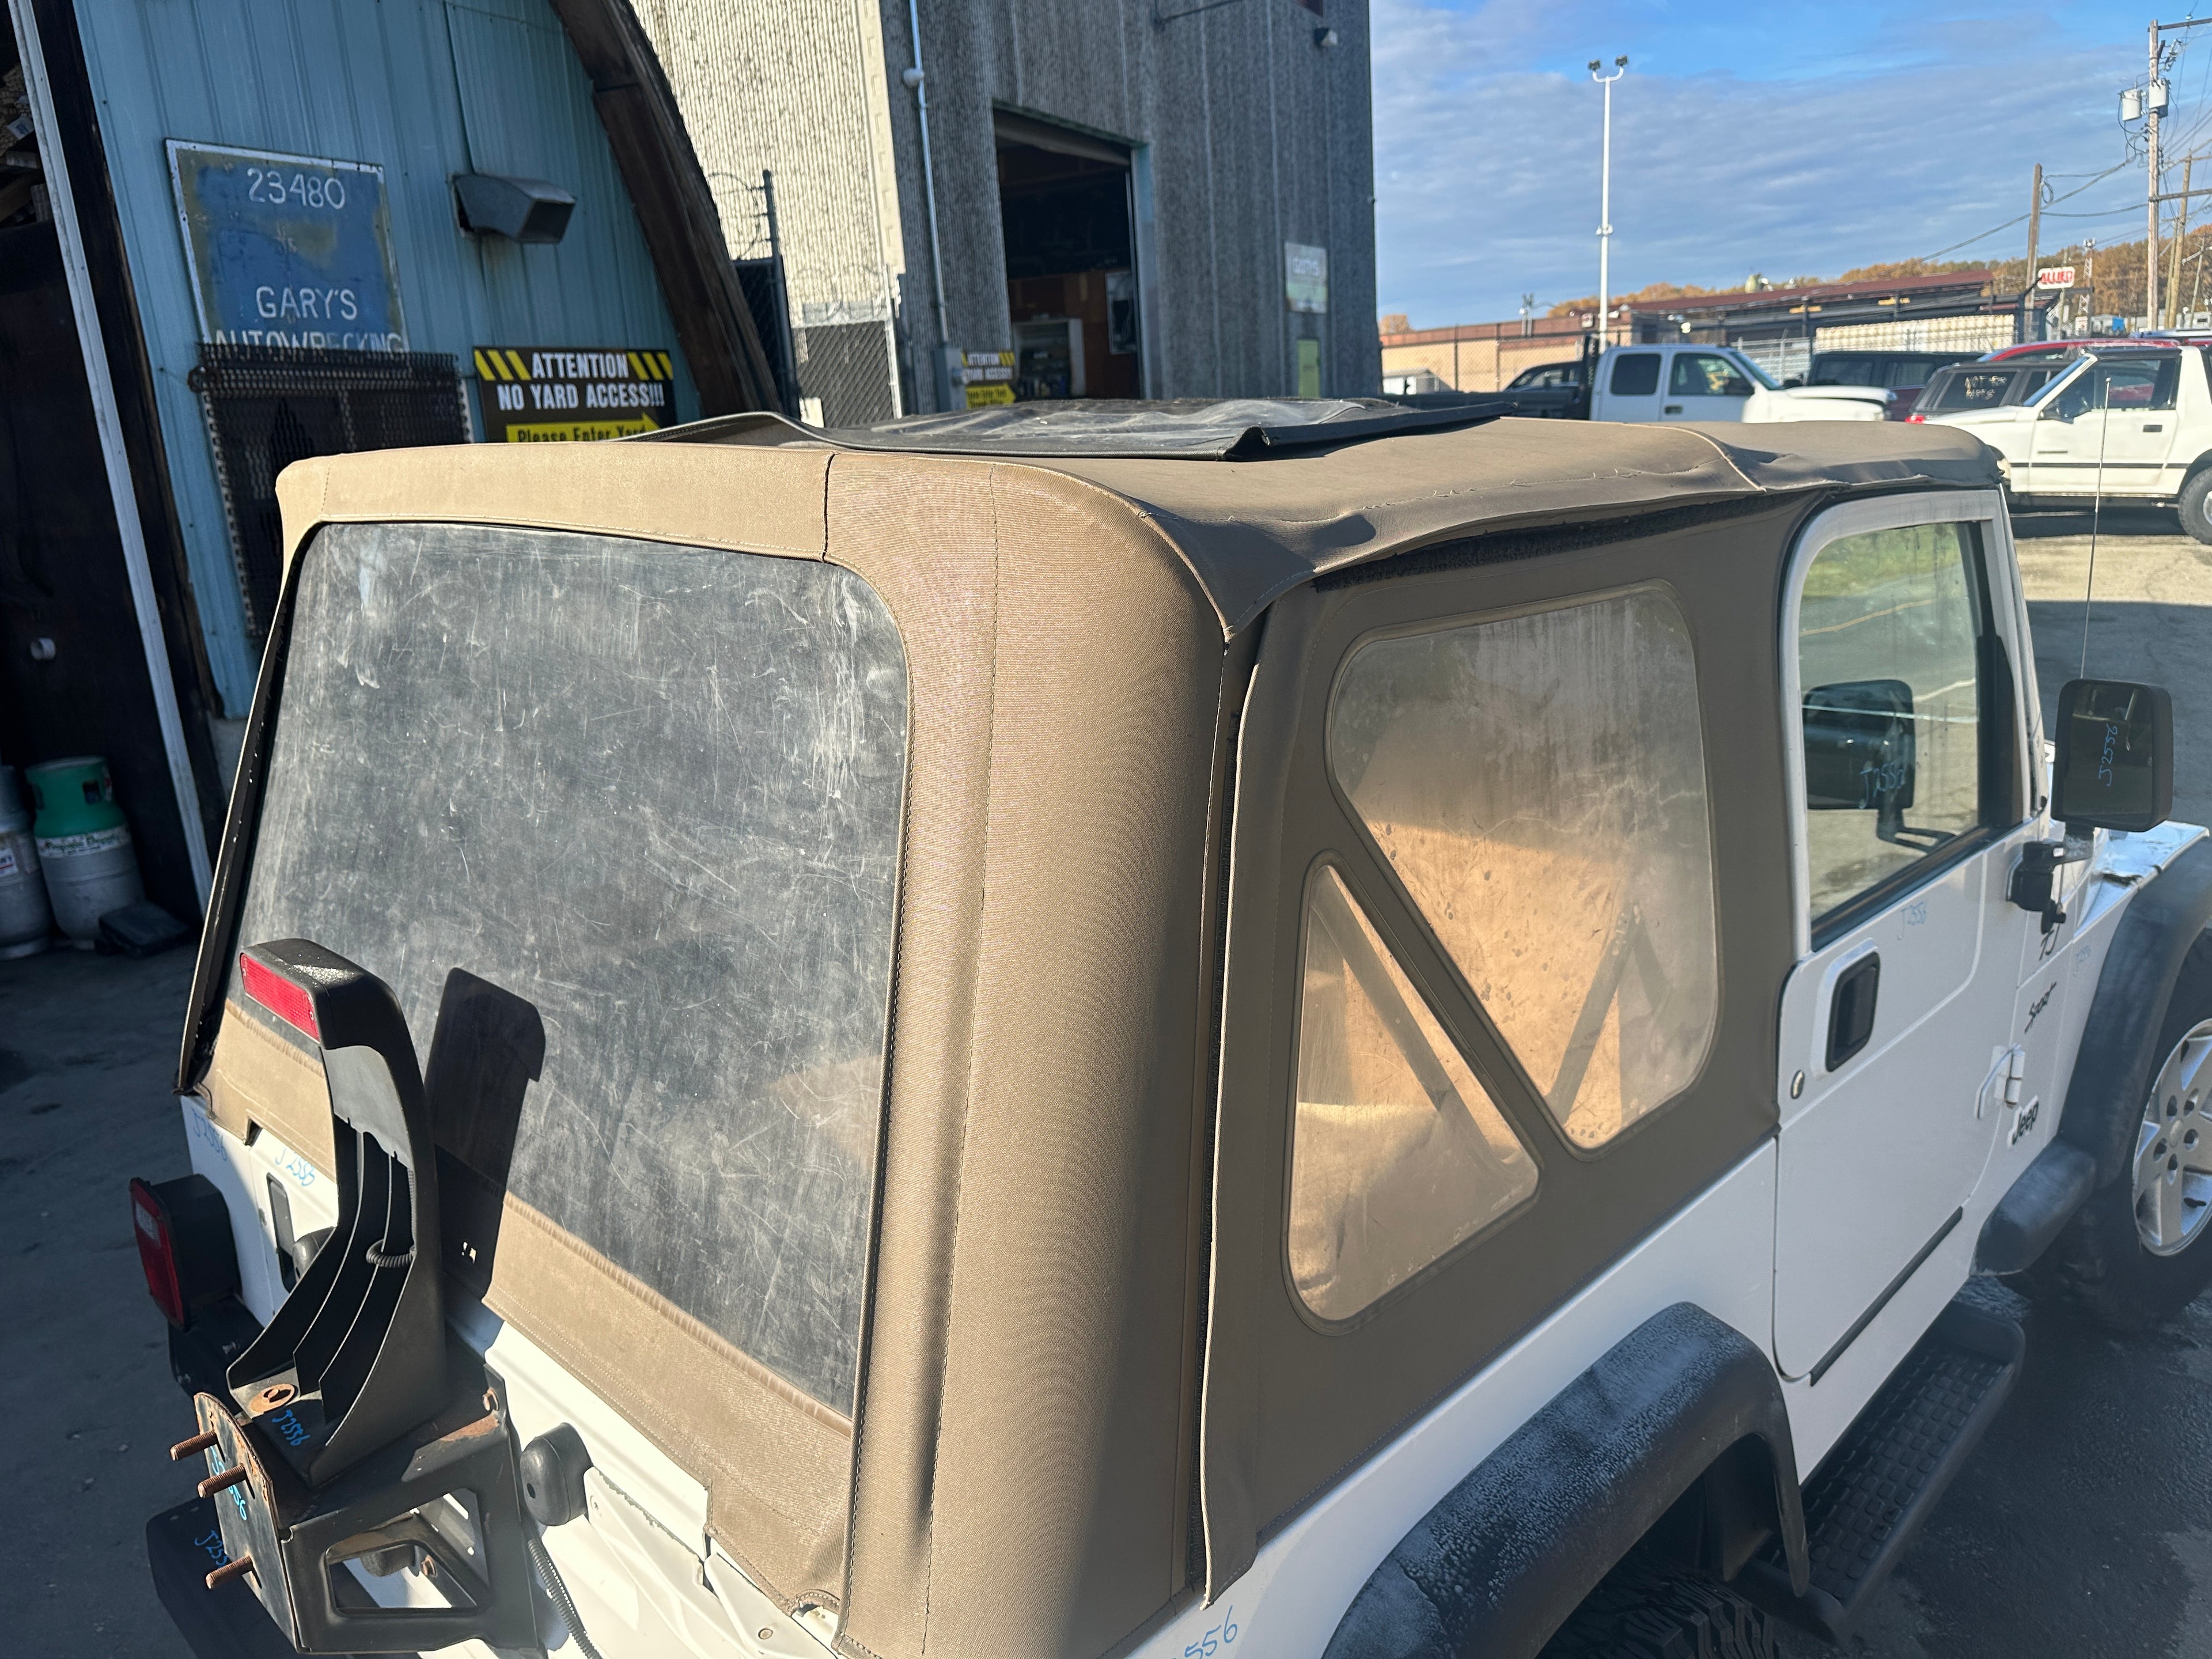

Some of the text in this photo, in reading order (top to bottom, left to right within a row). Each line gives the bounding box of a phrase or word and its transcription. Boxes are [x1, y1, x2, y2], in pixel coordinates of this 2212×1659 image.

[247, 168, 346, 209] 23480
[256, 286, 358, 320] GARY'S
[532, 352, 630, 378] ATTENTION
[497, 382, 665, 410] NO YARD ACCESS!!!
[2099, 723, 2118, 787] J2556
[2011, 1099, 2039, 1146] Jeep
[271, 1409, 311, 1446] J2556
[194, 1529, 228, 1568] J255
